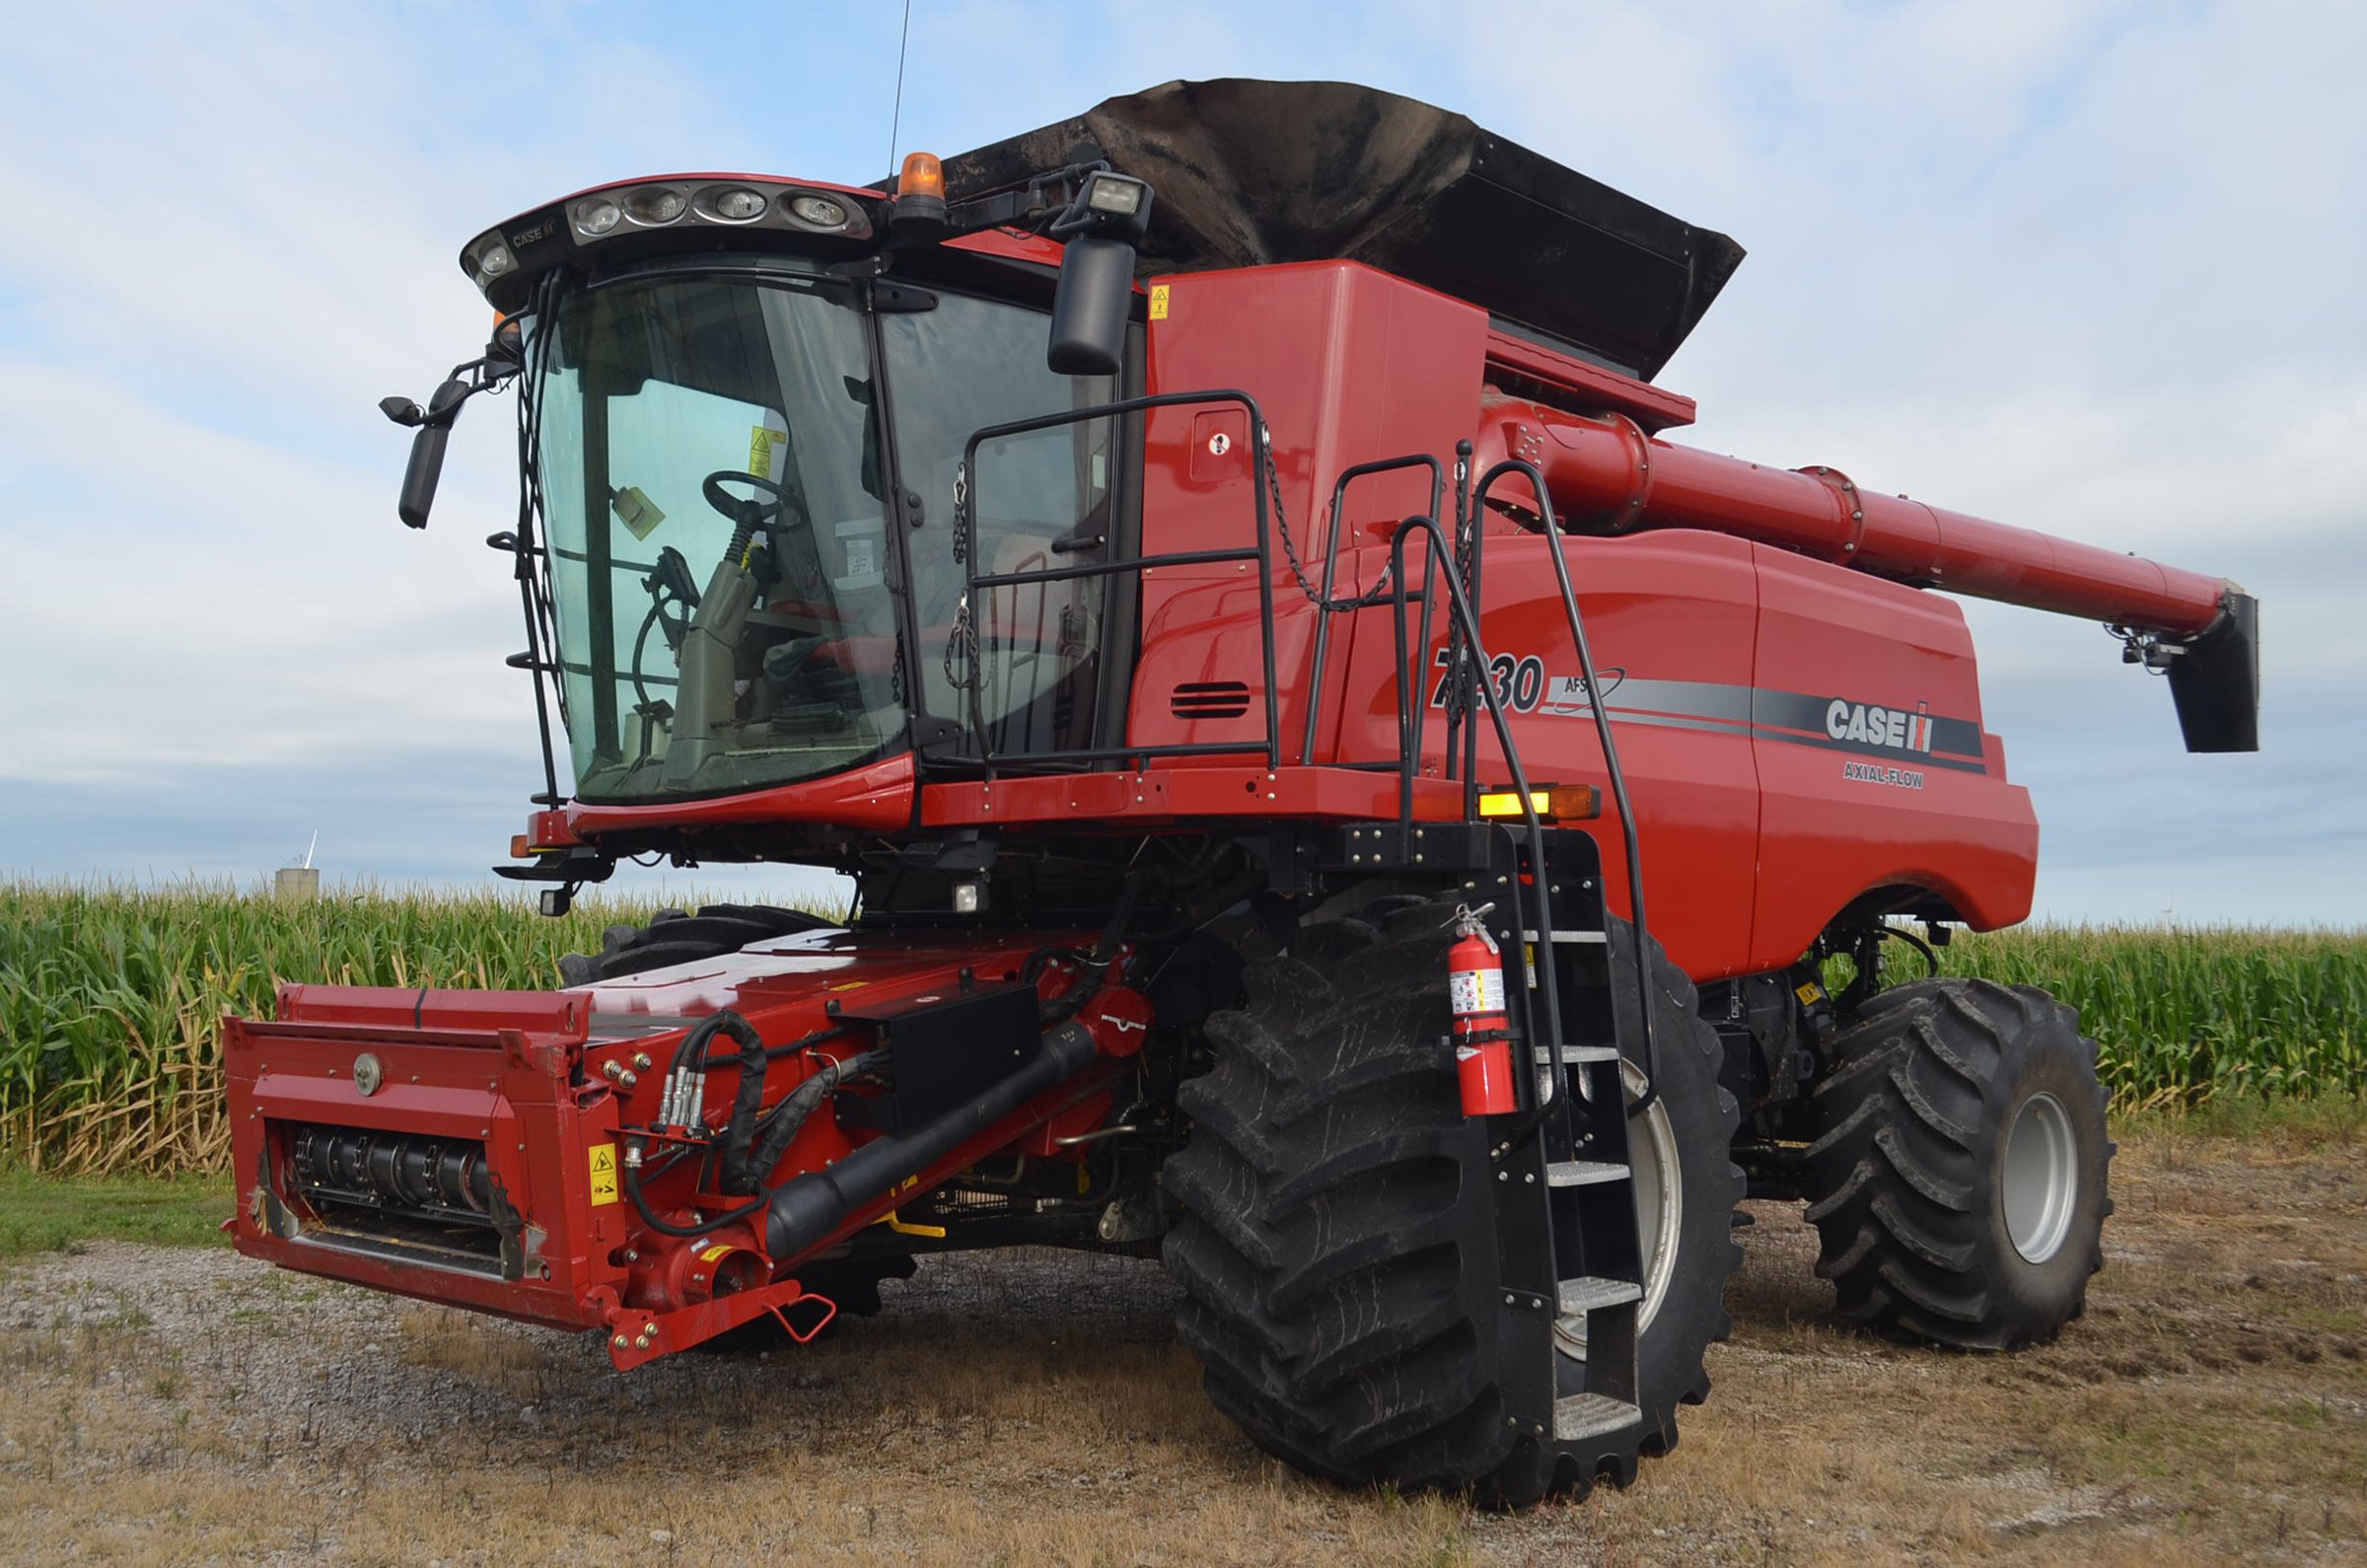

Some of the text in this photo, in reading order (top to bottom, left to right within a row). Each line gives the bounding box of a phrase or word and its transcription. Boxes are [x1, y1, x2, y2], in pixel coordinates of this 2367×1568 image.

[513, 227, 543, 248] CASE
[1827, 699, 1906, 748] CASE
[1843, 760, 1924, 790] AXIAL-FLOW
